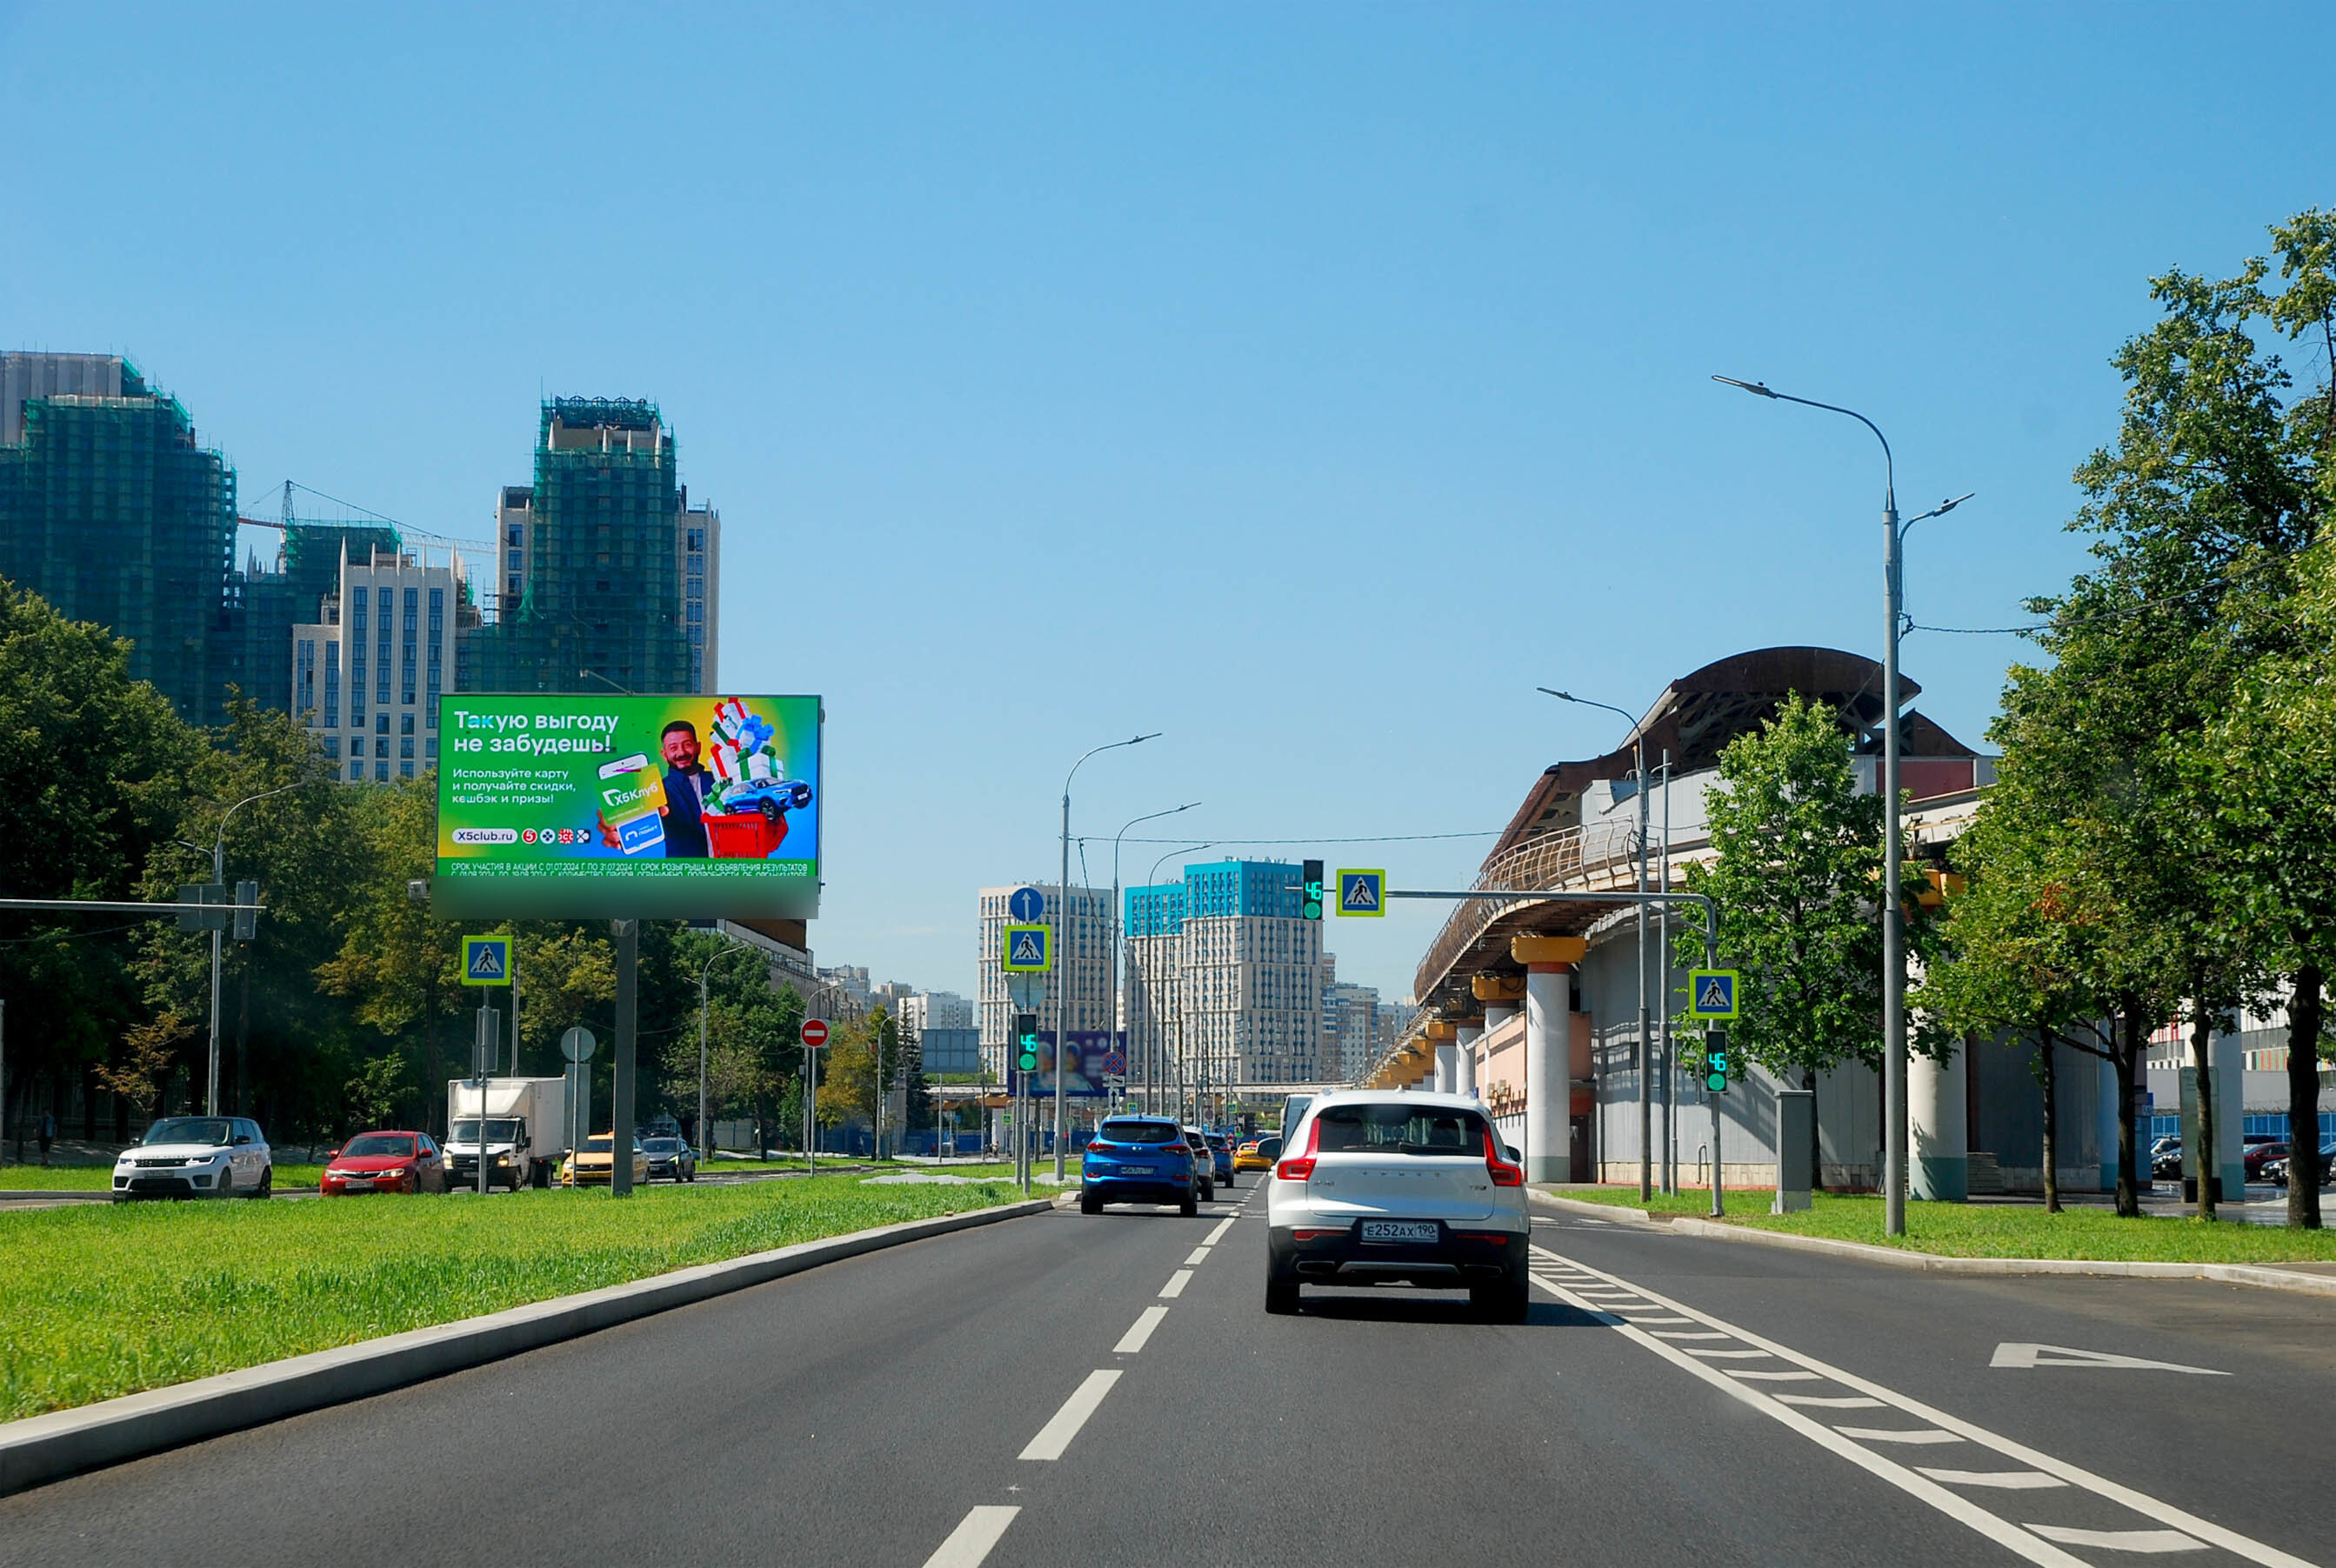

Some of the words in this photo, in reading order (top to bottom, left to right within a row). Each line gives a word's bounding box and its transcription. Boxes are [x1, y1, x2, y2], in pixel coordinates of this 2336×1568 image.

[454, 711, 530, 733] Такую
[535, 715, 619, 734] выгоду
[453, 737, 484, 752] не
[490, 733, 611, 757] забудешь!
[453, 769, 532, 781] Используйте
[535, 771, 569, 781] карту
[452, 783, 461, 791] и
[464, 782, 527, 793] получайте
[530, 783, 577, 792] скидки,
[452, 793, 497, 804] кешбэк
[512, 794, 554, 805] призы!
[457, 831, 513, 841] X5club.ru
[1305, 882, 1322, 900] 46
[1020, 1034, 1037, 1052] 46
[1709, 1053, 1726, 1071] 46
[1367, 1224, 1414, 1237] Е252АХ
[1418, 1224, 1434, 1235] 190
